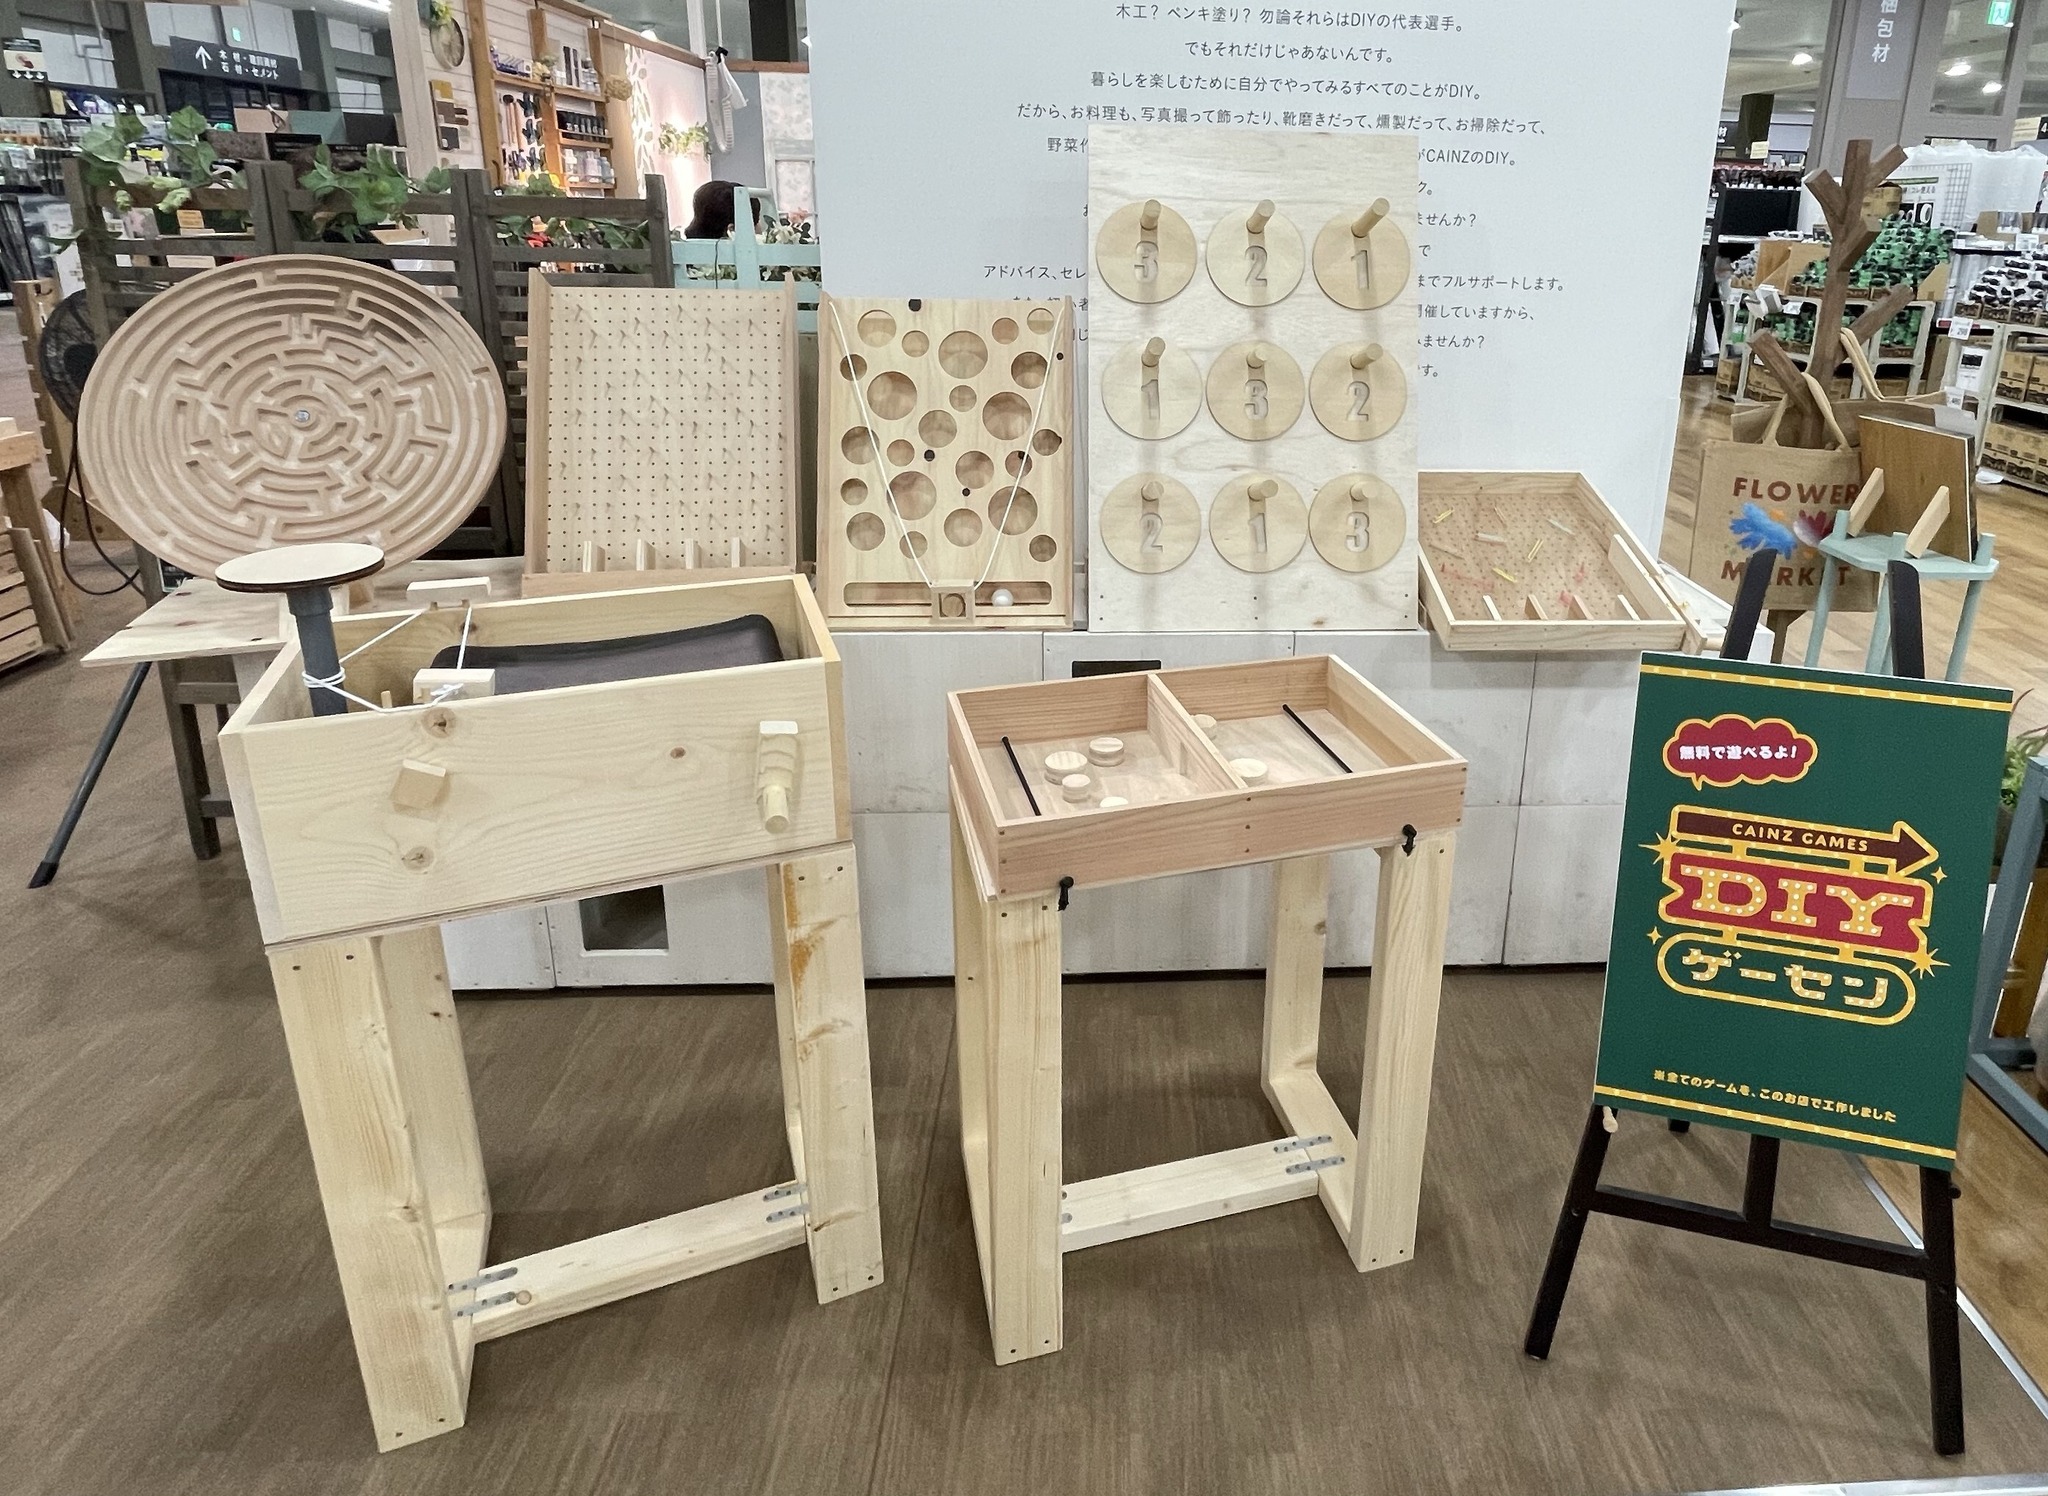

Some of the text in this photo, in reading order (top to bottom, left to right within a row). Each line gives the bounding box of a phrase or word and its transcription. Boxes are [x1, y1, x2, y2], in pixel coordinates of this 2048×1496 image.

[1184, 40, 1394, 64] でもそれだけじゃあないんです。
[1091, 71, 1481, 101] 暮らしを楽しむために自分でやってみるすべてのことがDIY。
[1134, 240, 1159, 283] 3
[1244, 245, 1268, 287] 2
[1350, 249, 1370, 290] 1
[1417, 335, 1486, 350] ませんか？
[1140, 378, 1161, 421] 1
[1244, 379, 1269, 421] 3
[1346, 381, 1369, 422] 2
[1732, 476, 1861, 505] FLOWER
[1139, 512, 1163, 554] 2
[1247, 512, 1268, 553] 1
[1345, 511, 1370, 553] 3
[1720, 559, 1851, 587] MRKT
[1679, 744, 1798, 760] 無料で遊べるよ！
[1731, 822, 1869, 853] CAINZ GAMES
[1680, 863, 1914, 938] DIY
[1681, 947, 1890, 1009] ゲーセン
